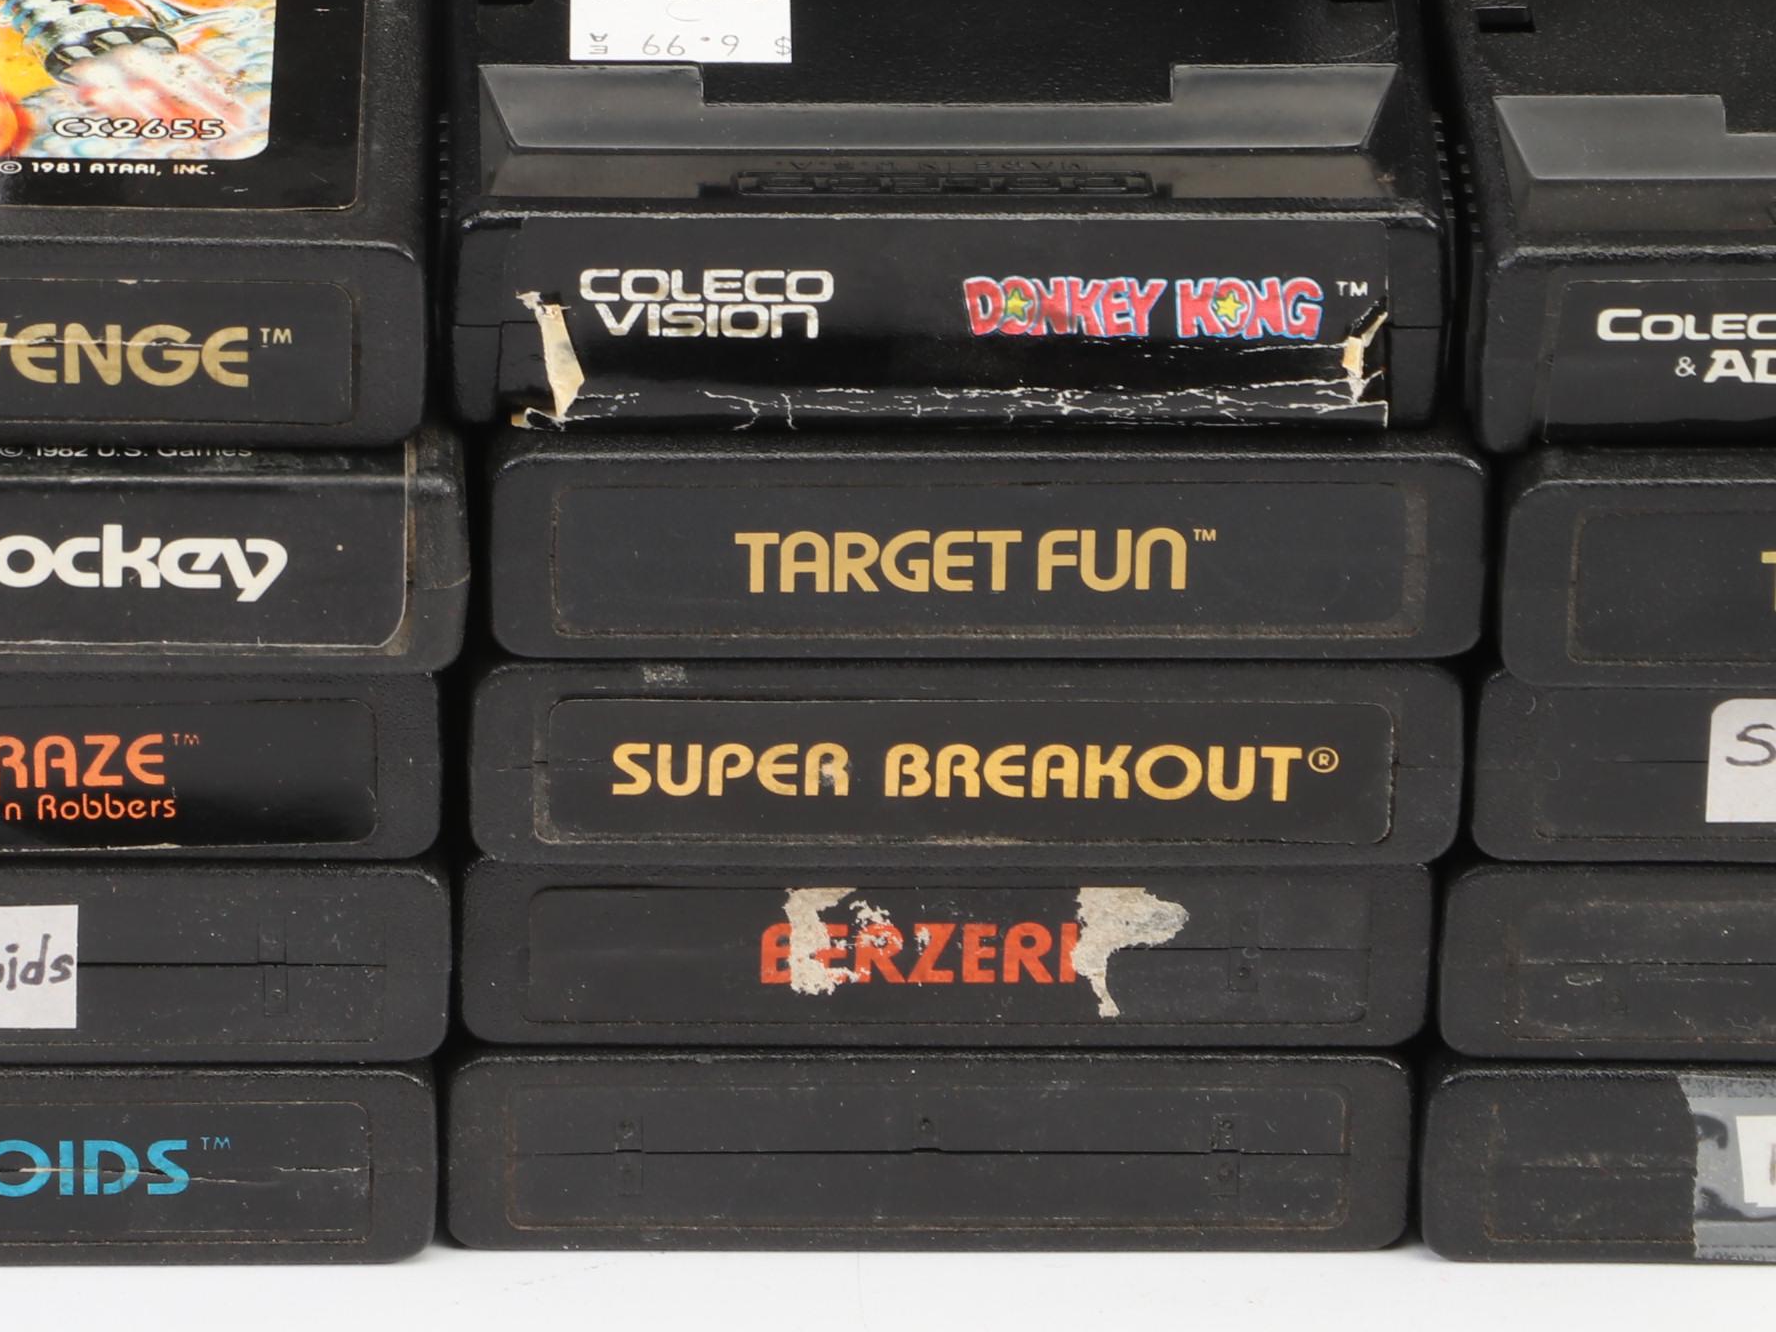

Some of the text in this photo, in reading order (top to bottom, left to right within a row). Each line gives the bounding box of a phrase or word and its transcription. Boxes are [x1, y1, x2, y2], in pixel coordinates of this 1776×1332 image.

[52, 116, 227, 140] CX2655
[31, 162, 82, 175] 1981
[90, 163, 162, 177] ATARI,
[172, 164, 216, 176] INC.
[579, 268, 835, 302] COLECO
[594, 302, 820, 339] VISION
[962, 275, 1168, 338] DONKEY
[1596, 308, 1776, 342] COLEC
[1674, 349, 1776, 385] & AD
[734, 528, 1023, 594] TARGET
[1725, 722, 1776, 767] S
[612, 741, 850, 798] SUPER
[37, 793, 177, 822] Robbers
